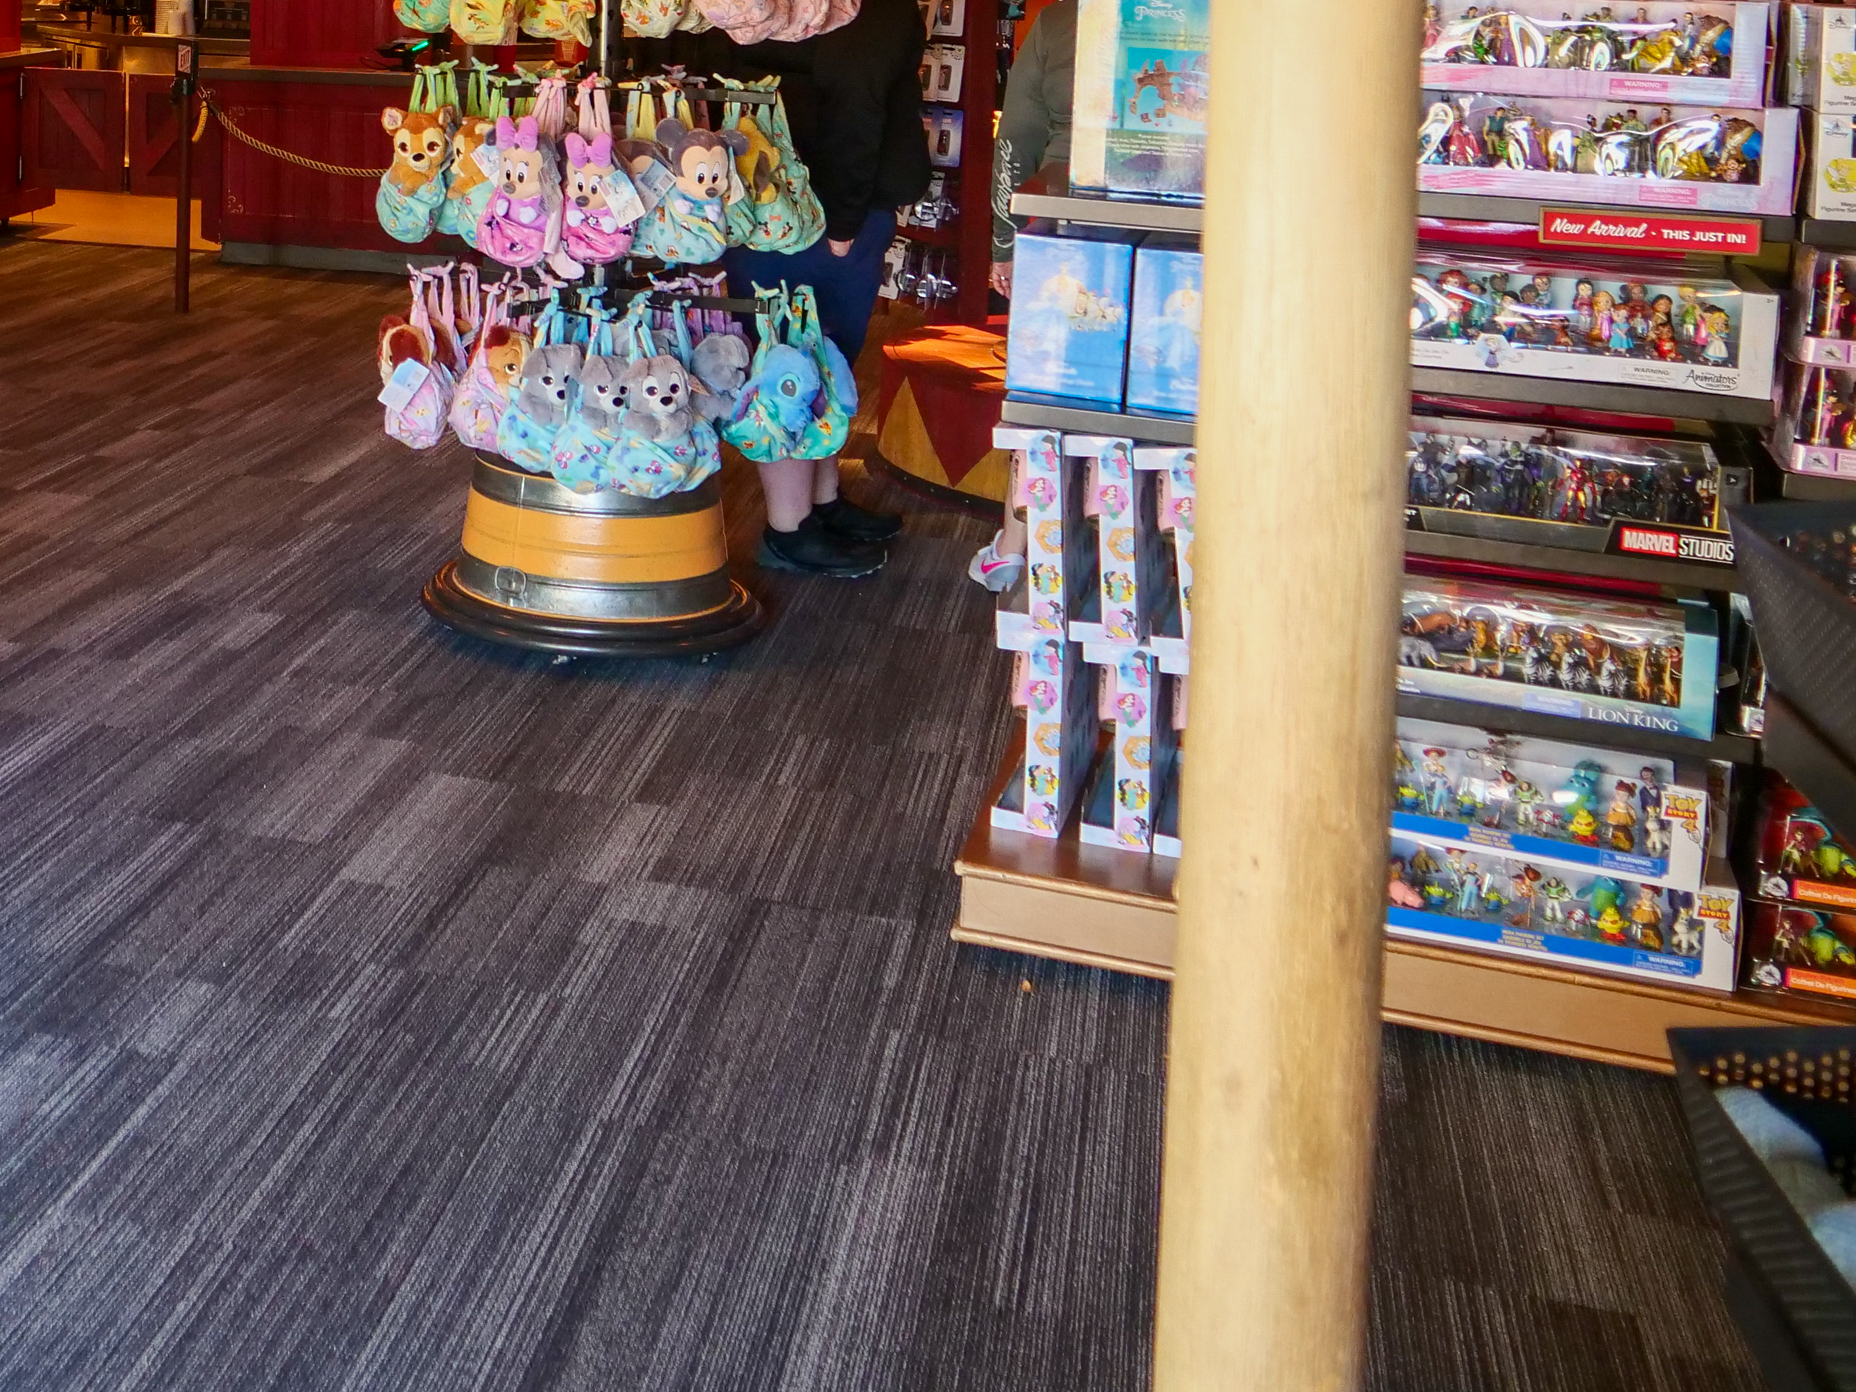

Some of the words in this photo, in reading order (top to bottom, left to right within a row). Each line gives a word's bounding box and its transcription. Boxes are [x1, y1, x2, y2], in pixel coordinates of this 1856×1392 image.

[1134, 6, 1187, 22] PRINCESS
[1550, 217, 1585, 234] New
[1587, 219, 1648, 240] Arrival
[1661, 228, 1690, 241] THIS
[1692, 230, 1725, 243] JUST
[1727, 232, 1747, 244] IN!
[1622, 529, 1678, 555] MARVEL
[1678, 535, 1734, 561] STUDIOS
[1588, 707, 1630, 727] LION
[1633, 712, 1679, 733] KING
[1664, 794, 1704, 811] TOY
[1668, 808, 1697, 818] STORY
[1614, 854, 1654, 868] WARNING:
[1697, 893, 1735, 911] TOY
[1699, 908, 1729, 918] STORY
[1648, 954, 1687, 969] WARNING:
